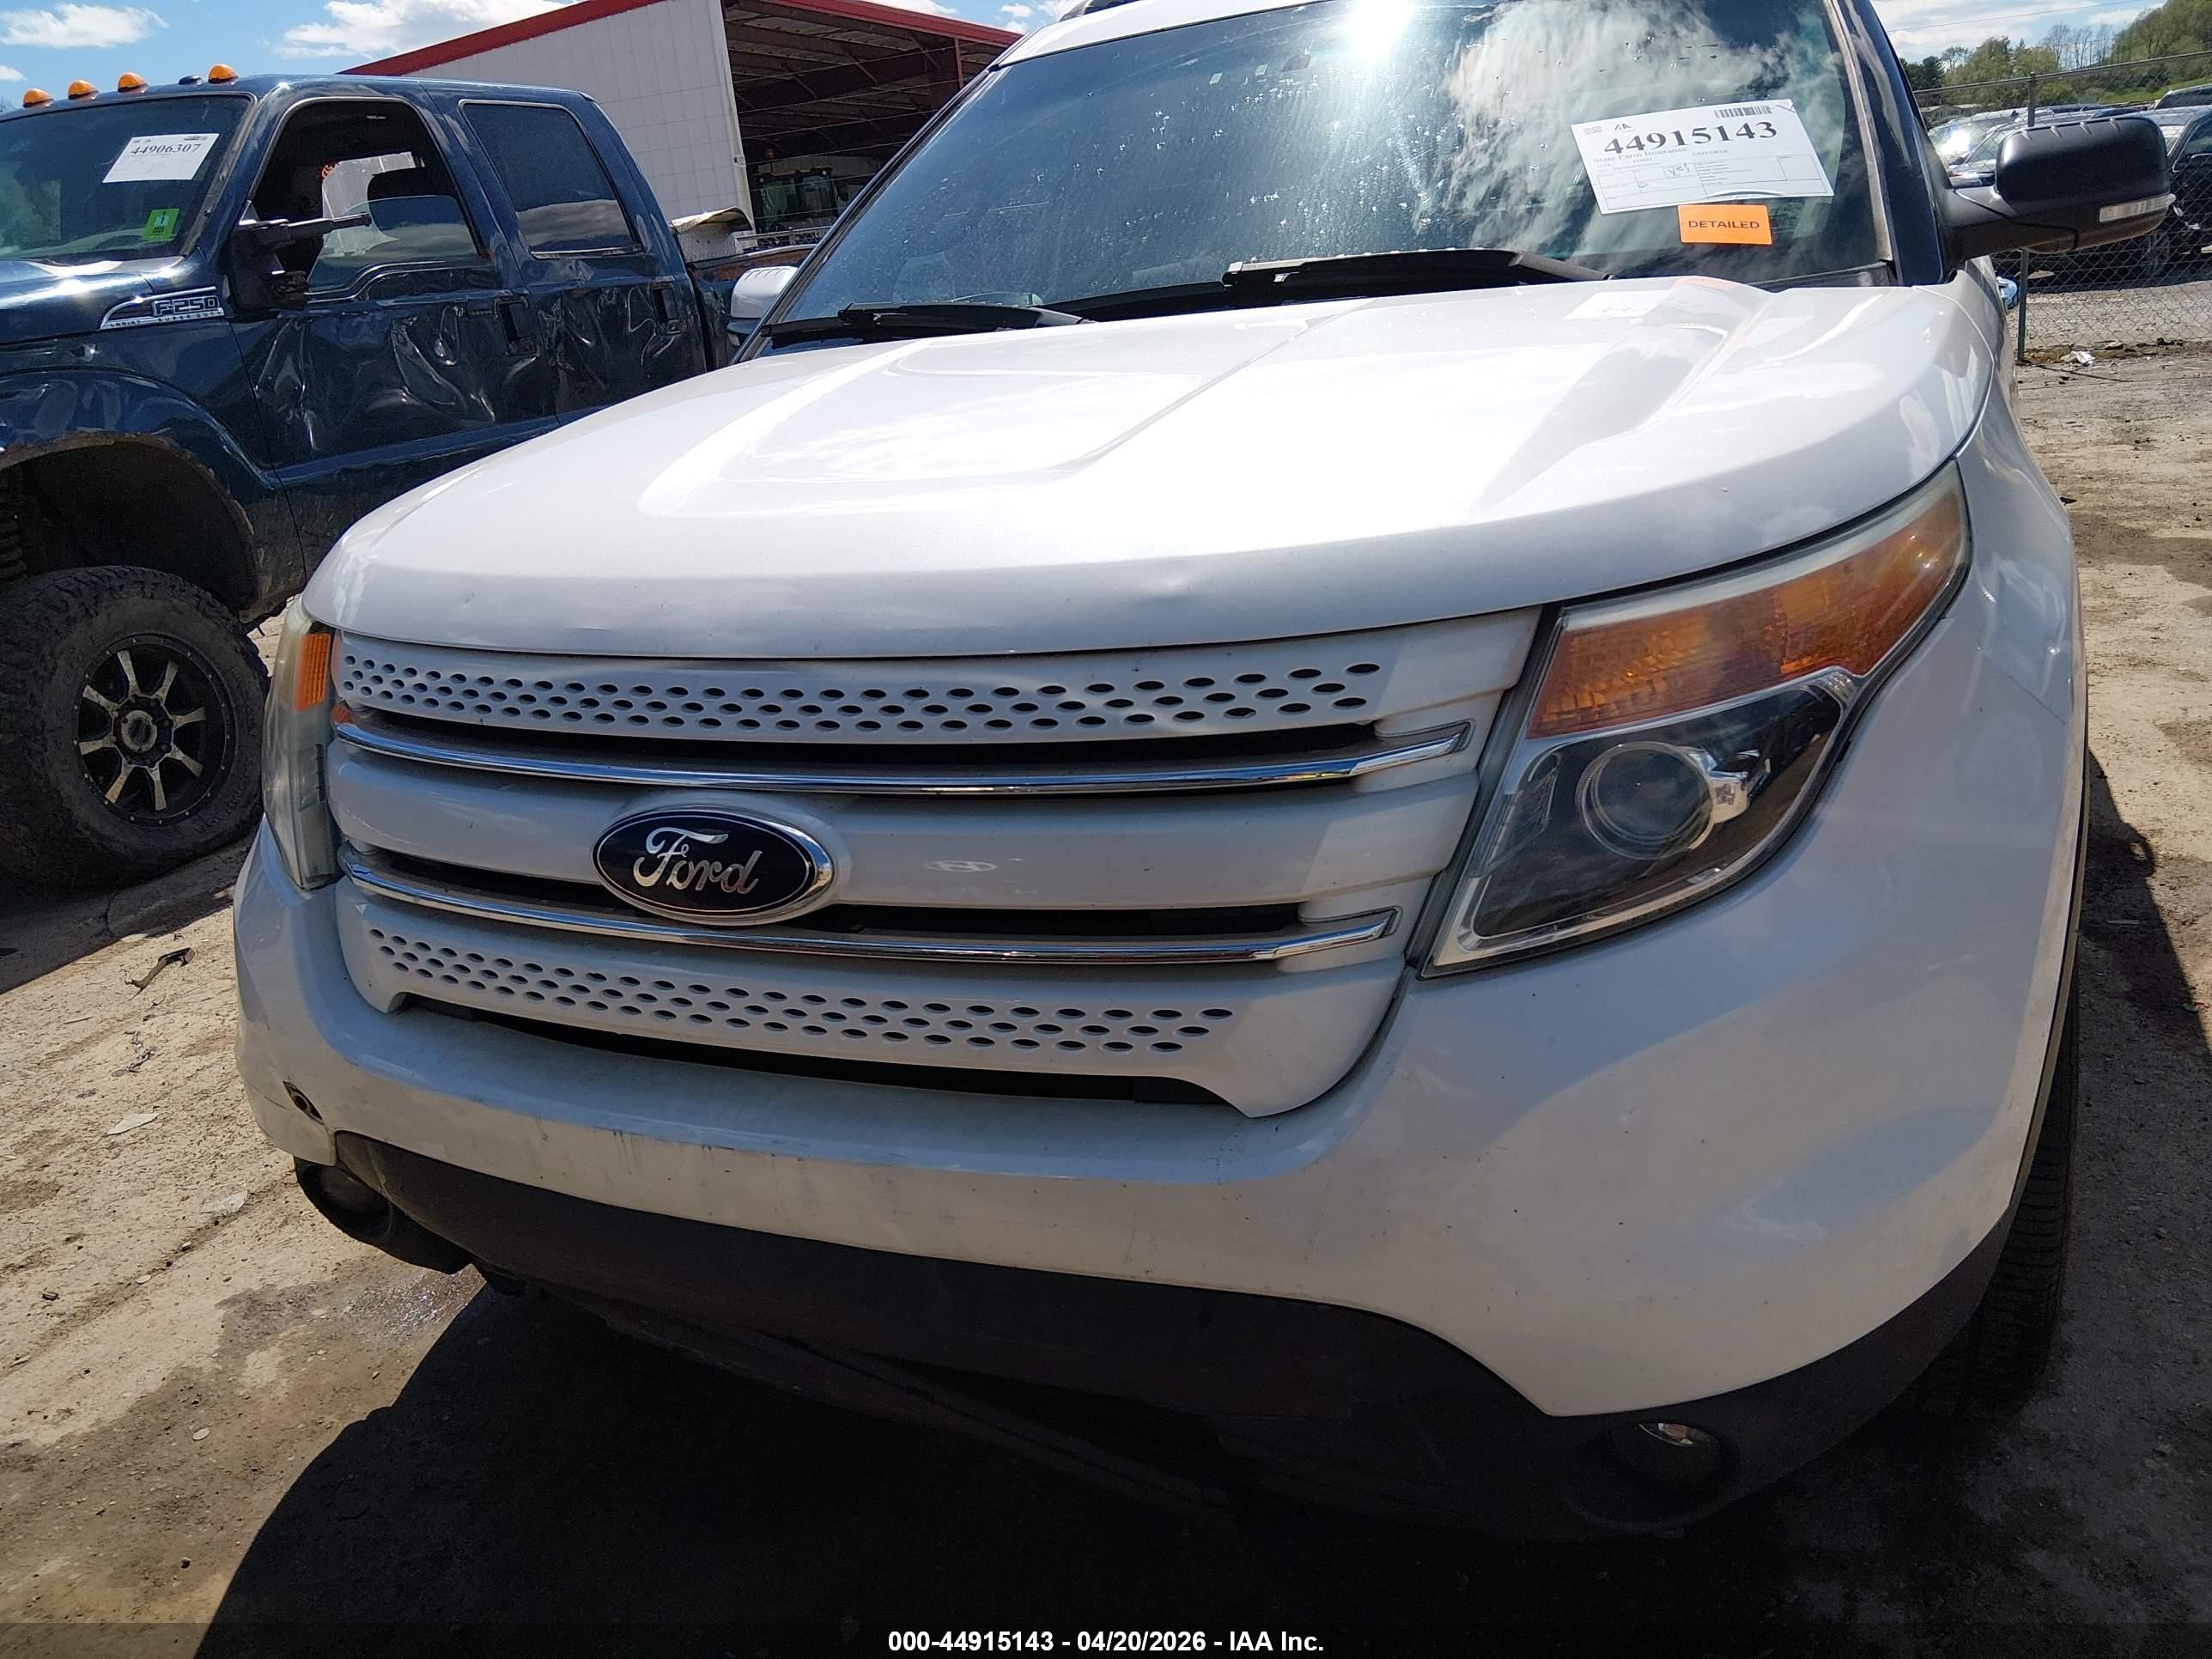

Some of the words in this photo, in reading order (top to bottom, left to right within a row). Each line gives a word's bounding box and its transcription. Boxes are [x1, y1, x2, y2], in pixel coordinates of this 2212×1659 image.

[1603, 121, 1778, 155] 44915143
[130, 143, 202, 155] 44906307
[1644, 147, 1687, 155] Insurance
[1688, 220, 1760, 229] DETAILED
[633, 826, 763, 895] Ford
